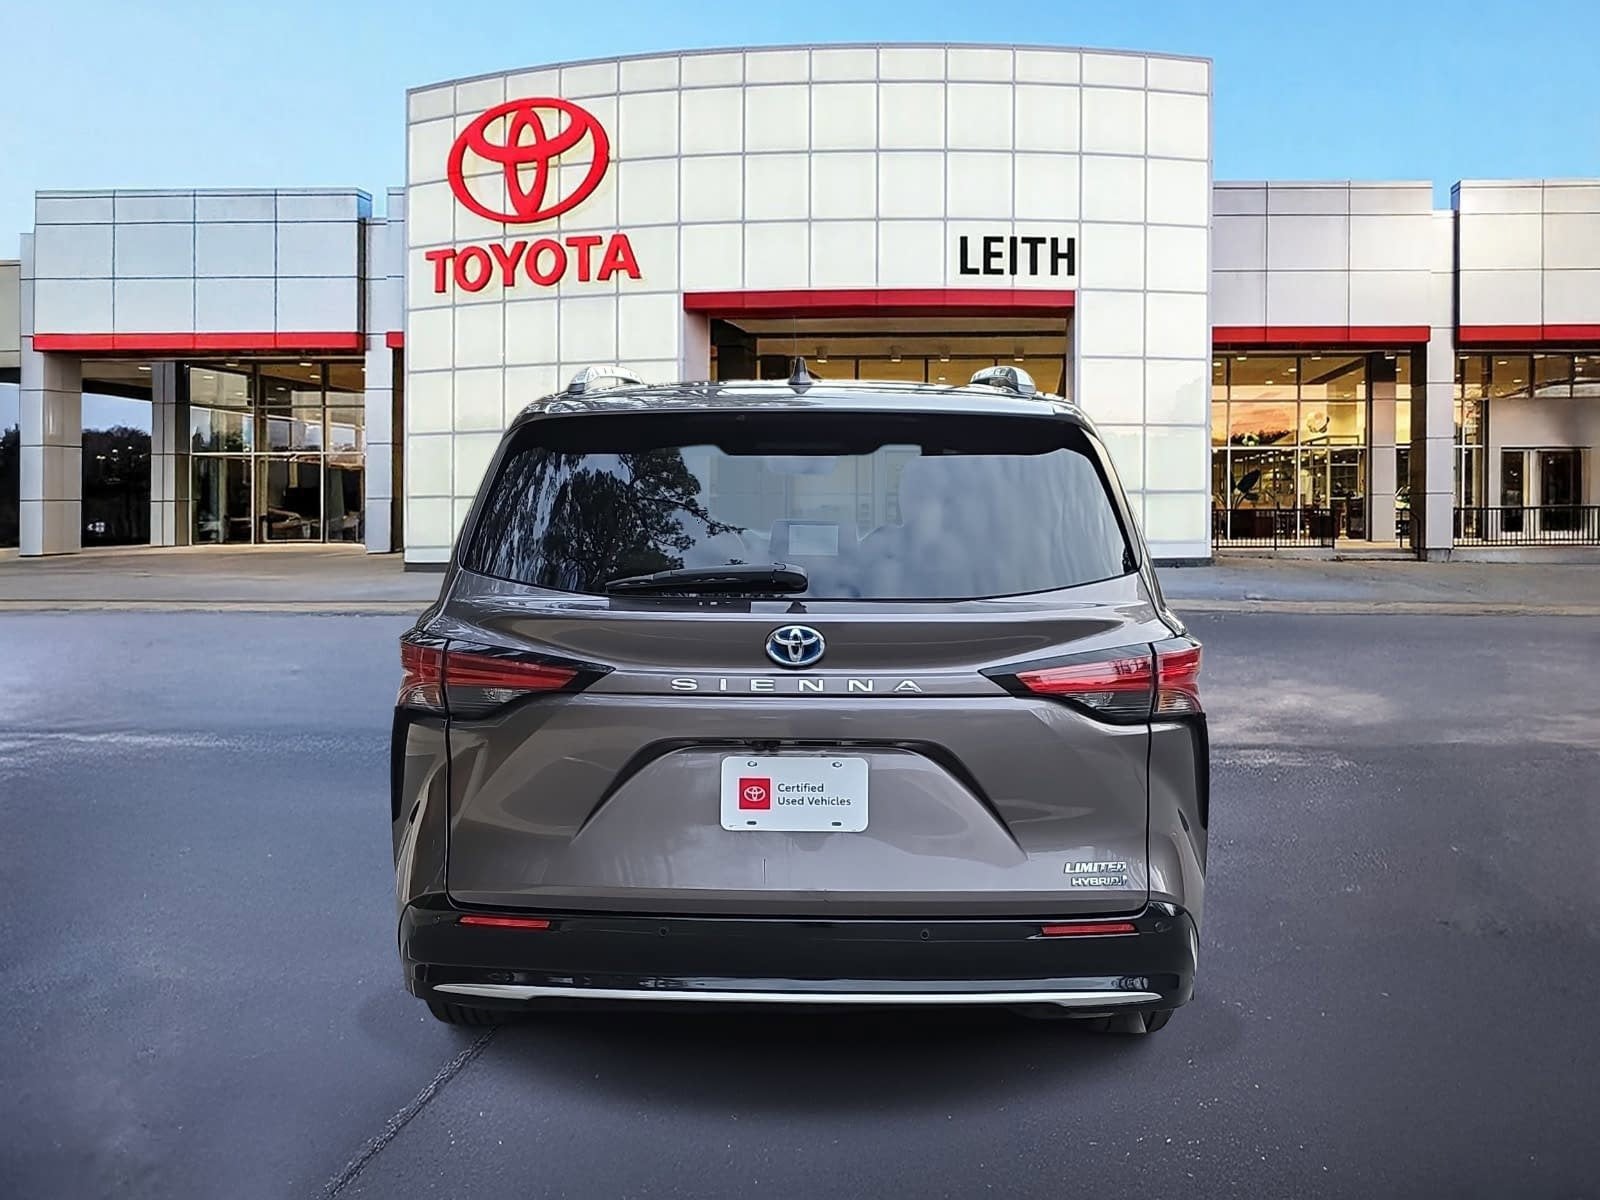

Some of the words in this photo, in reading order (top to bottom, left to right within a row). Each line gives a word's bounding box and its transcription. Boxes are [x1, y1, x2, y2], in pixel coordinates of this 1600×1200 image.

[960, 236, 1075, 276] LEITH
[425, 233, 642, 293] TOYOTA
[671, 678, 923, 692] SIENNA
[777, 782, 824, 794] Certified
[777, 796, 804, 806] Used
[807, 796, 851, 806] Vehicles
[1064, 861, 1127, 873] LIMITED
